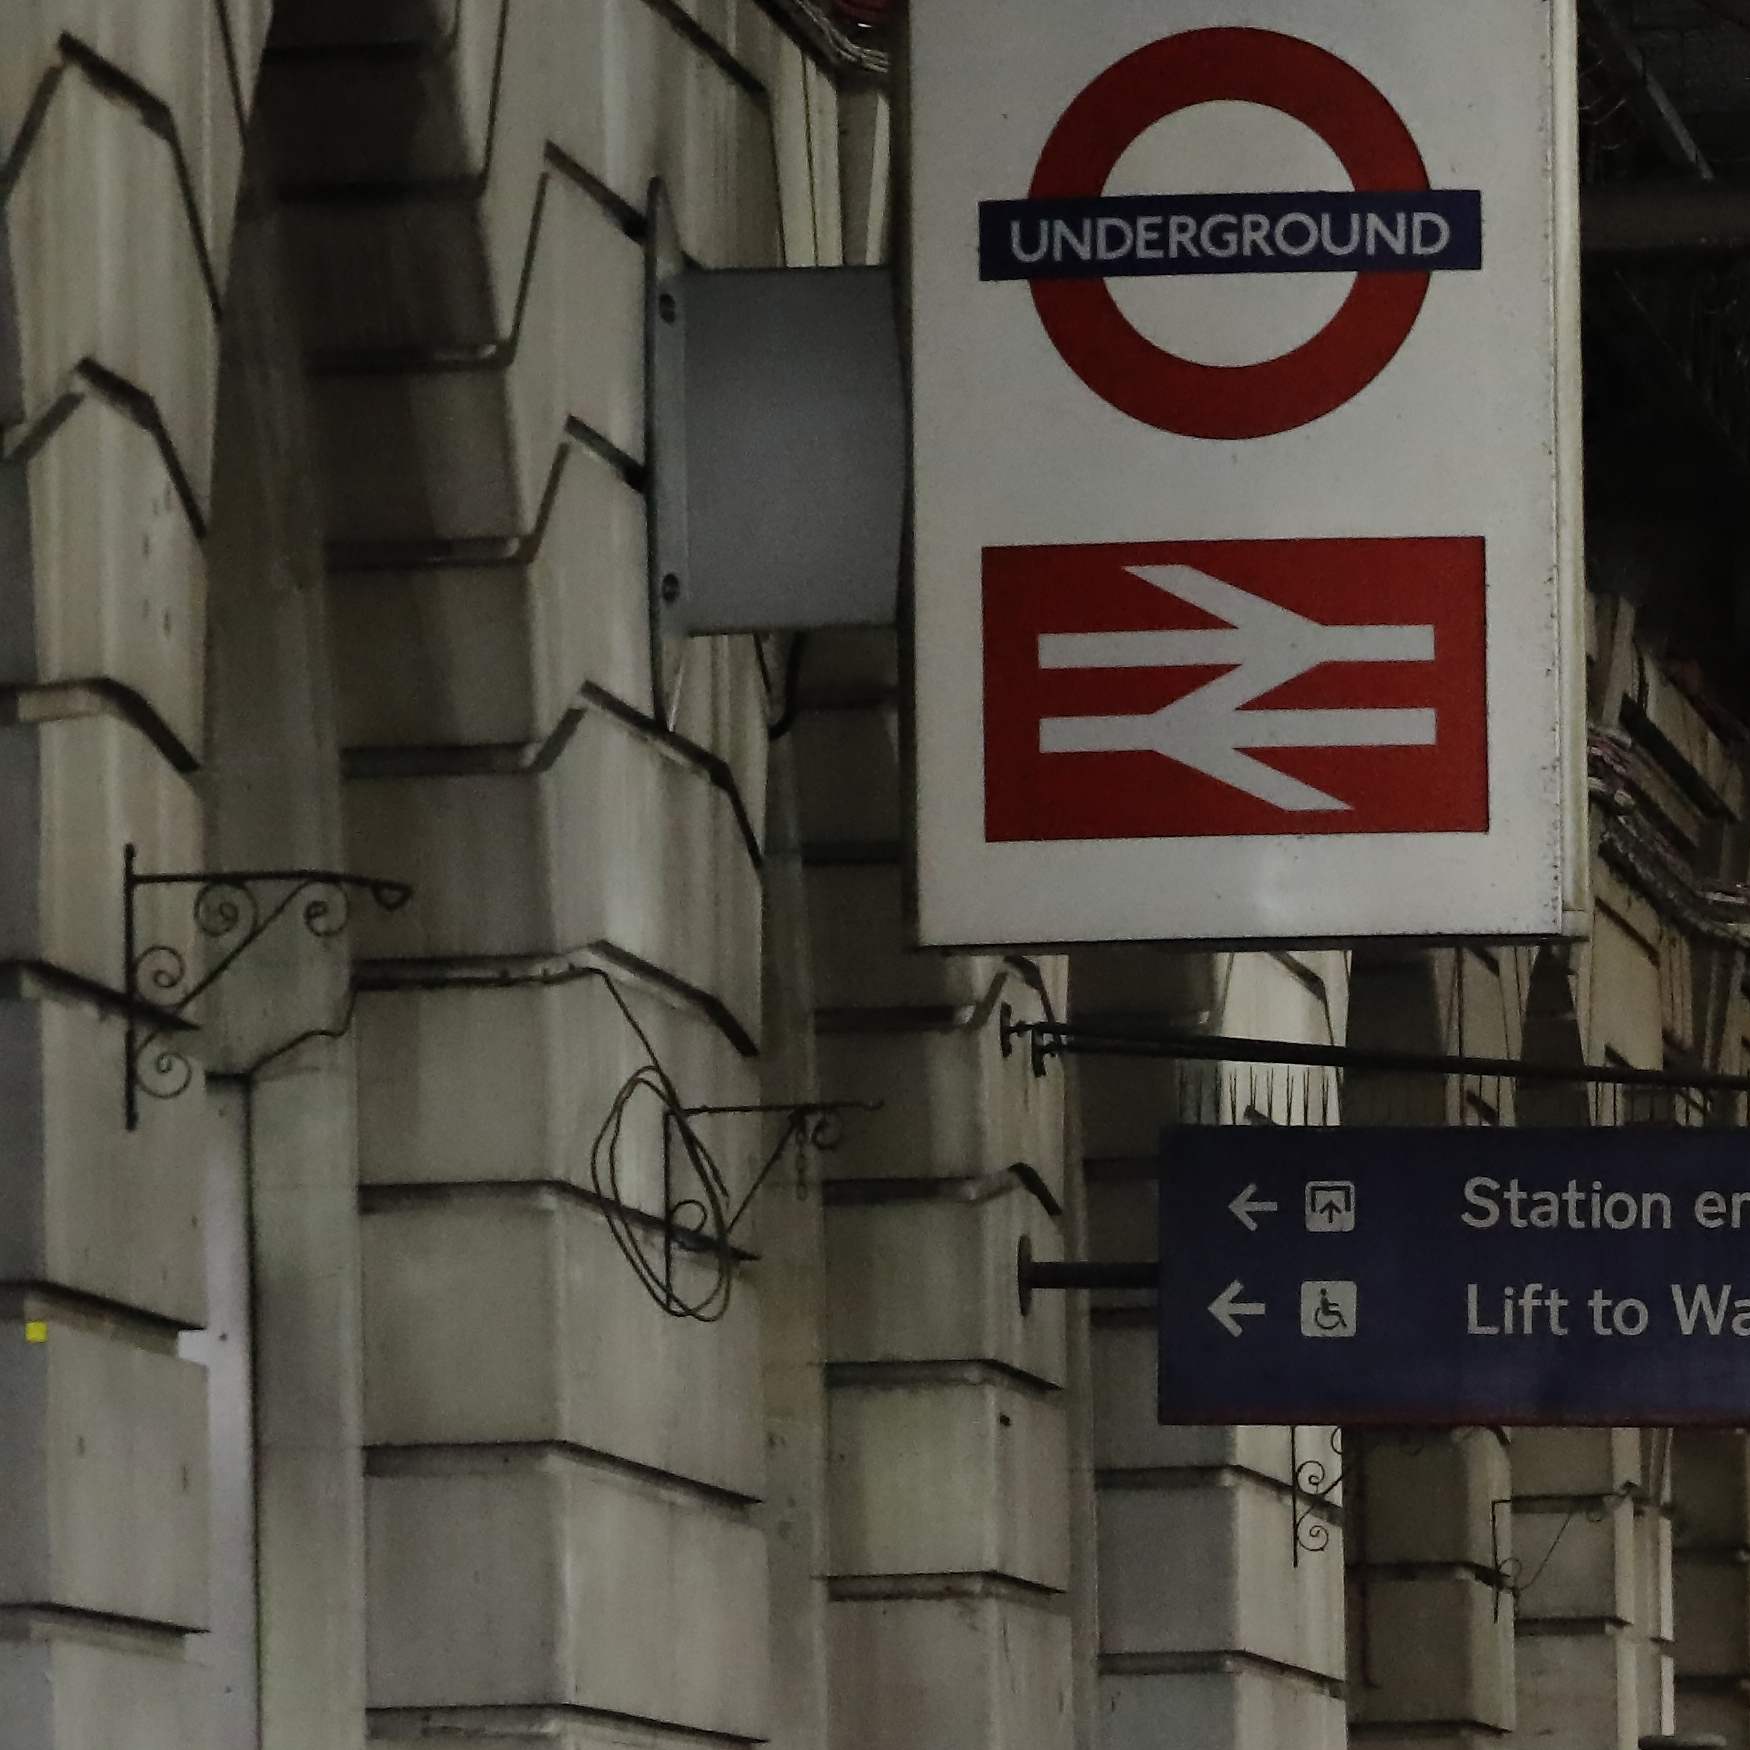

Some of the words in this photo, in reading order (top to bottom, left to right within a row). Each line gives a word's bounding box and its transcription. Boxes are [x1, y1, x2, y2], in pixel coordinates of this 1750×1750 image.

[1011, 211, 1450, 262] UNDERGROUND
[1461, 1176, 1672, 1229] Station
[1467, 1283, 1569, 1336] Lift
[1588, 1288, 1649, 1336] to
